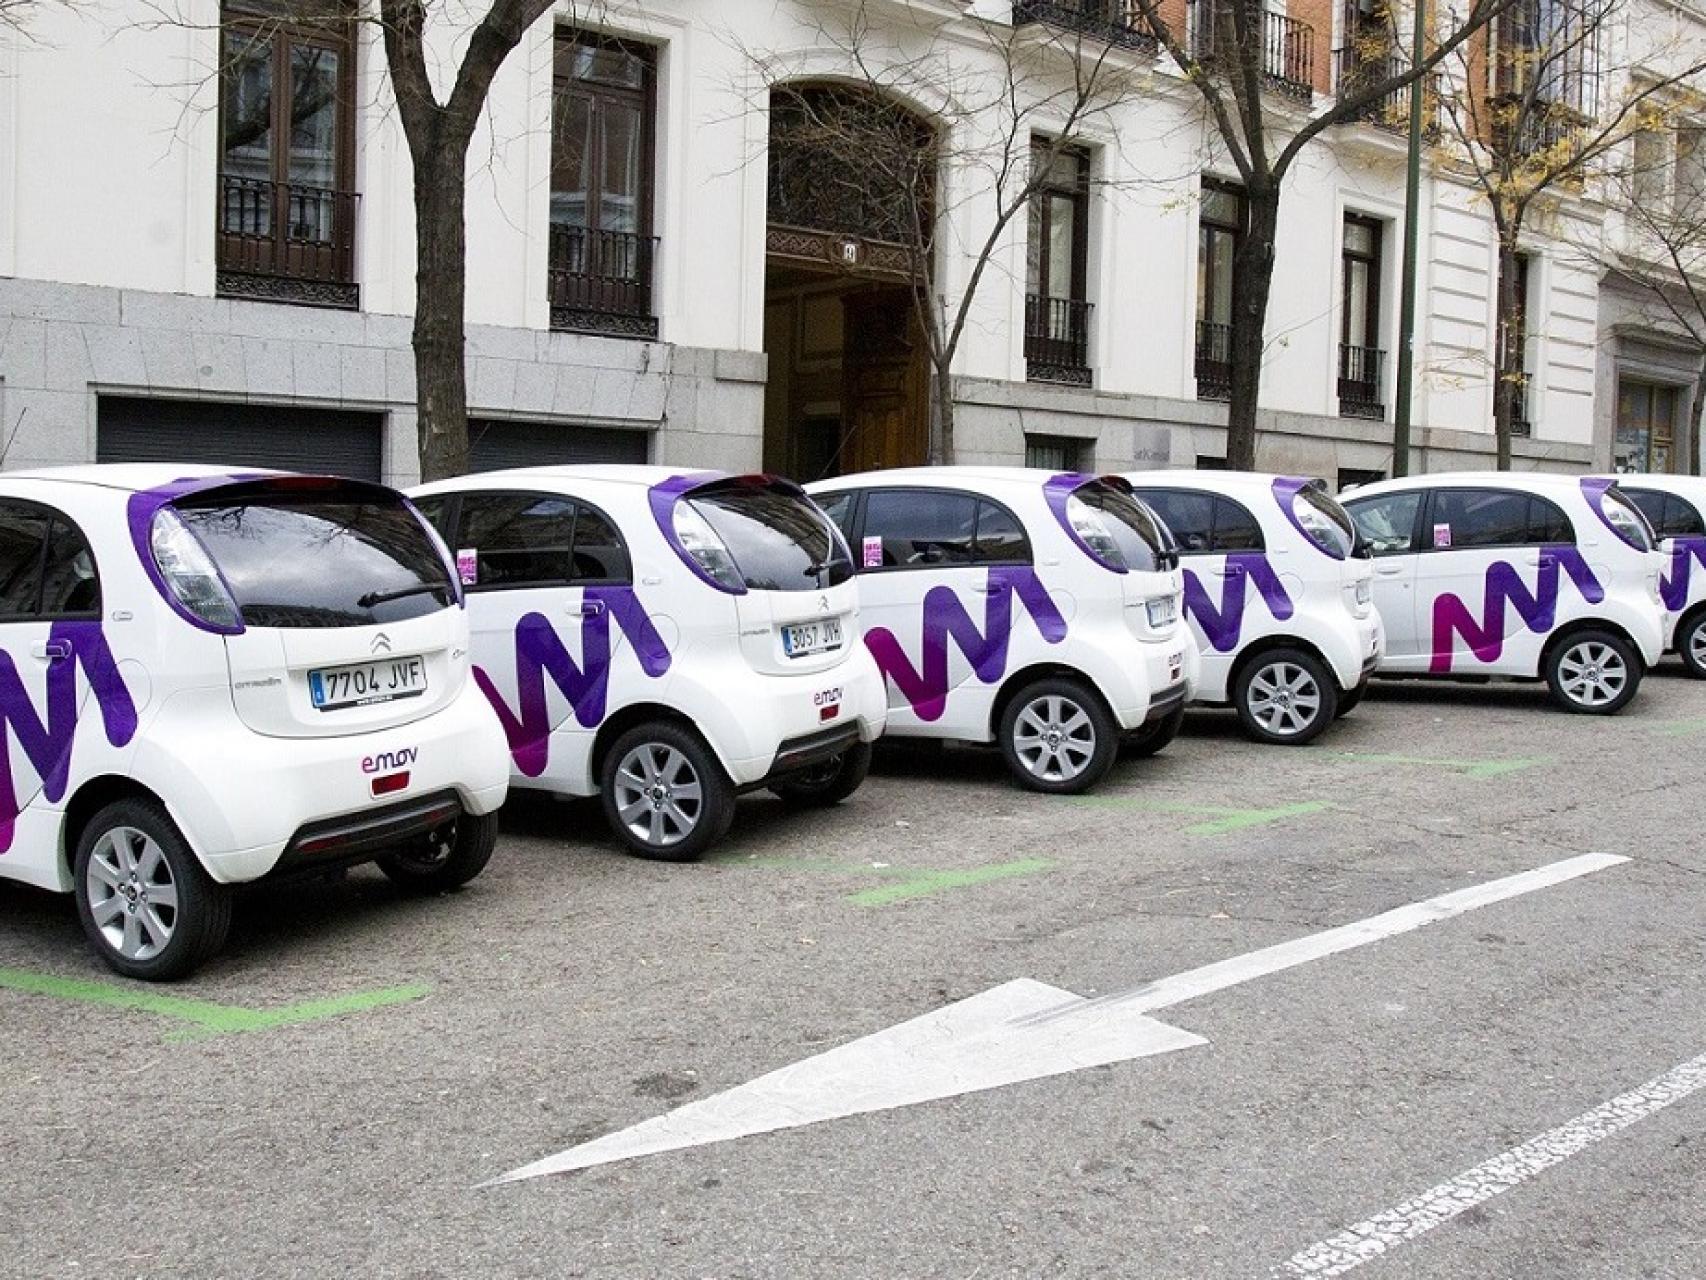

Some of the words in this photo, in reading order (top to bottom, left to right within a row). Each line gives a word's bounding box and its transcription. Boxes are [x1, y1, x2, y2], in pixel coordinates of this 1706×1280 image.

[326, 667, 380, 700] 7704
[388, 661, 419, 688] JVF
[362, 747, 419, 773] emov
